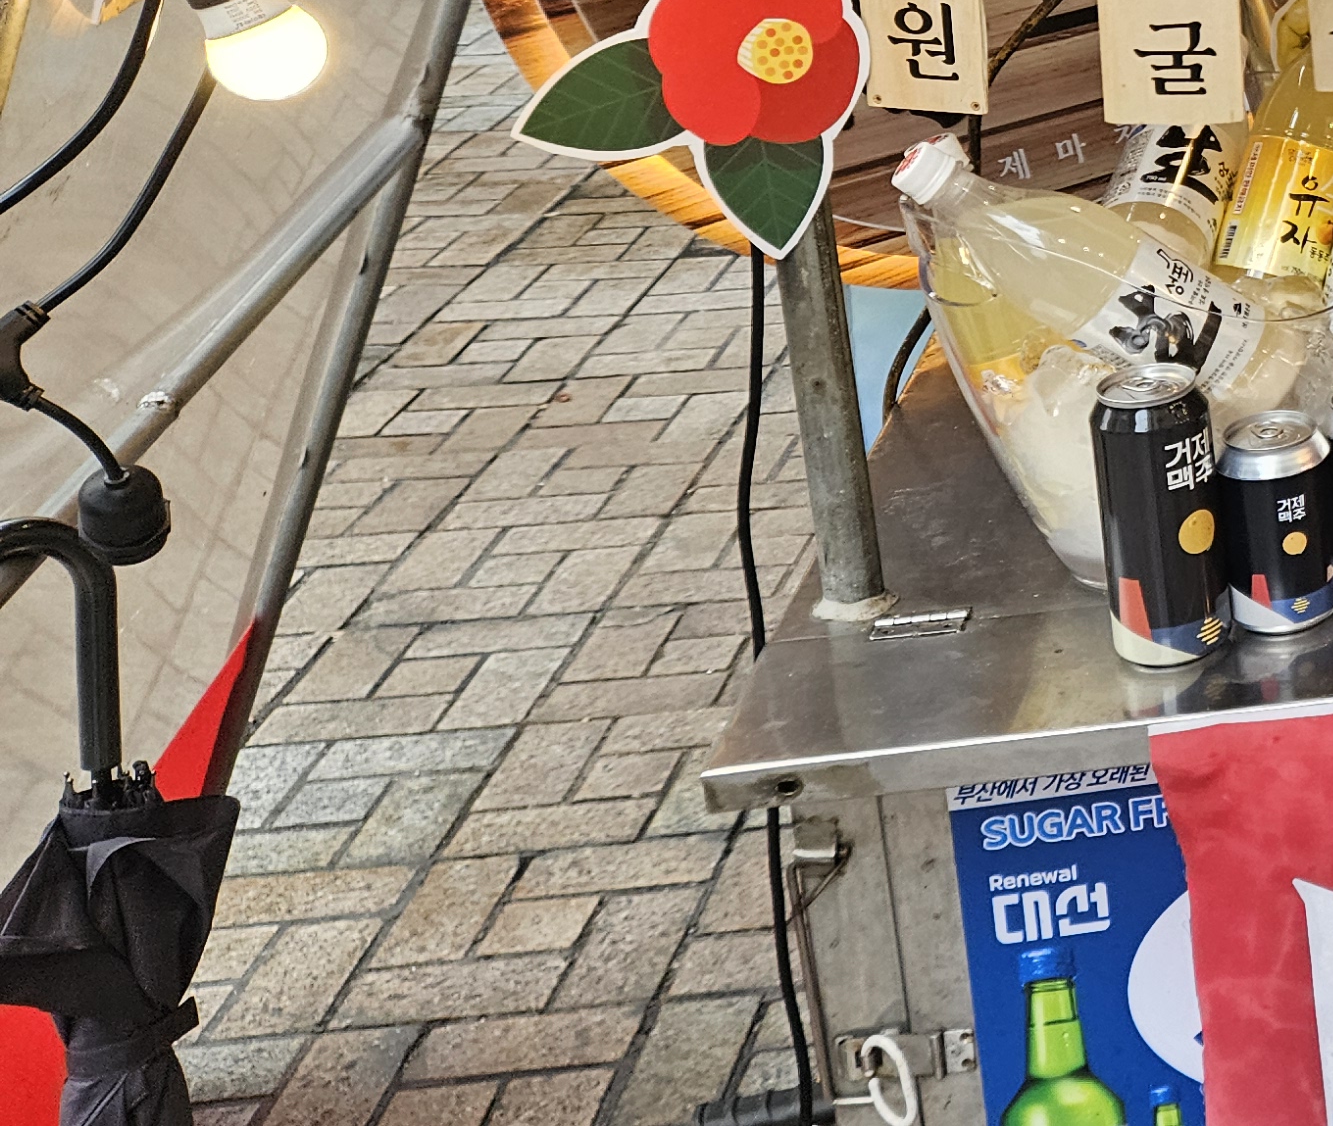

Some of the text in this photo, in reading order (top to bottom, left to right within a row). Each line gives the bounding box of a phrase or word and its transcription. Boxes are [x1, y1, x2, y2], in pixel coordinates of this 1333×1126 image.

[1280, 174, 1331, 254] 유자
[1164, 429, 1211, 471] 거제
[1166, 457, 1213, 491] 맥주
[1276, 493, 1306, 512] 거제
[1277, 506, 1307, 524] 맥주
[953, 777, 1039, 806] 부산에서
[979, 800, 1126, 852] SUGAR
[988, 864, 1078, 892] Renewal
[991, 882, 1111, 945] 대선
